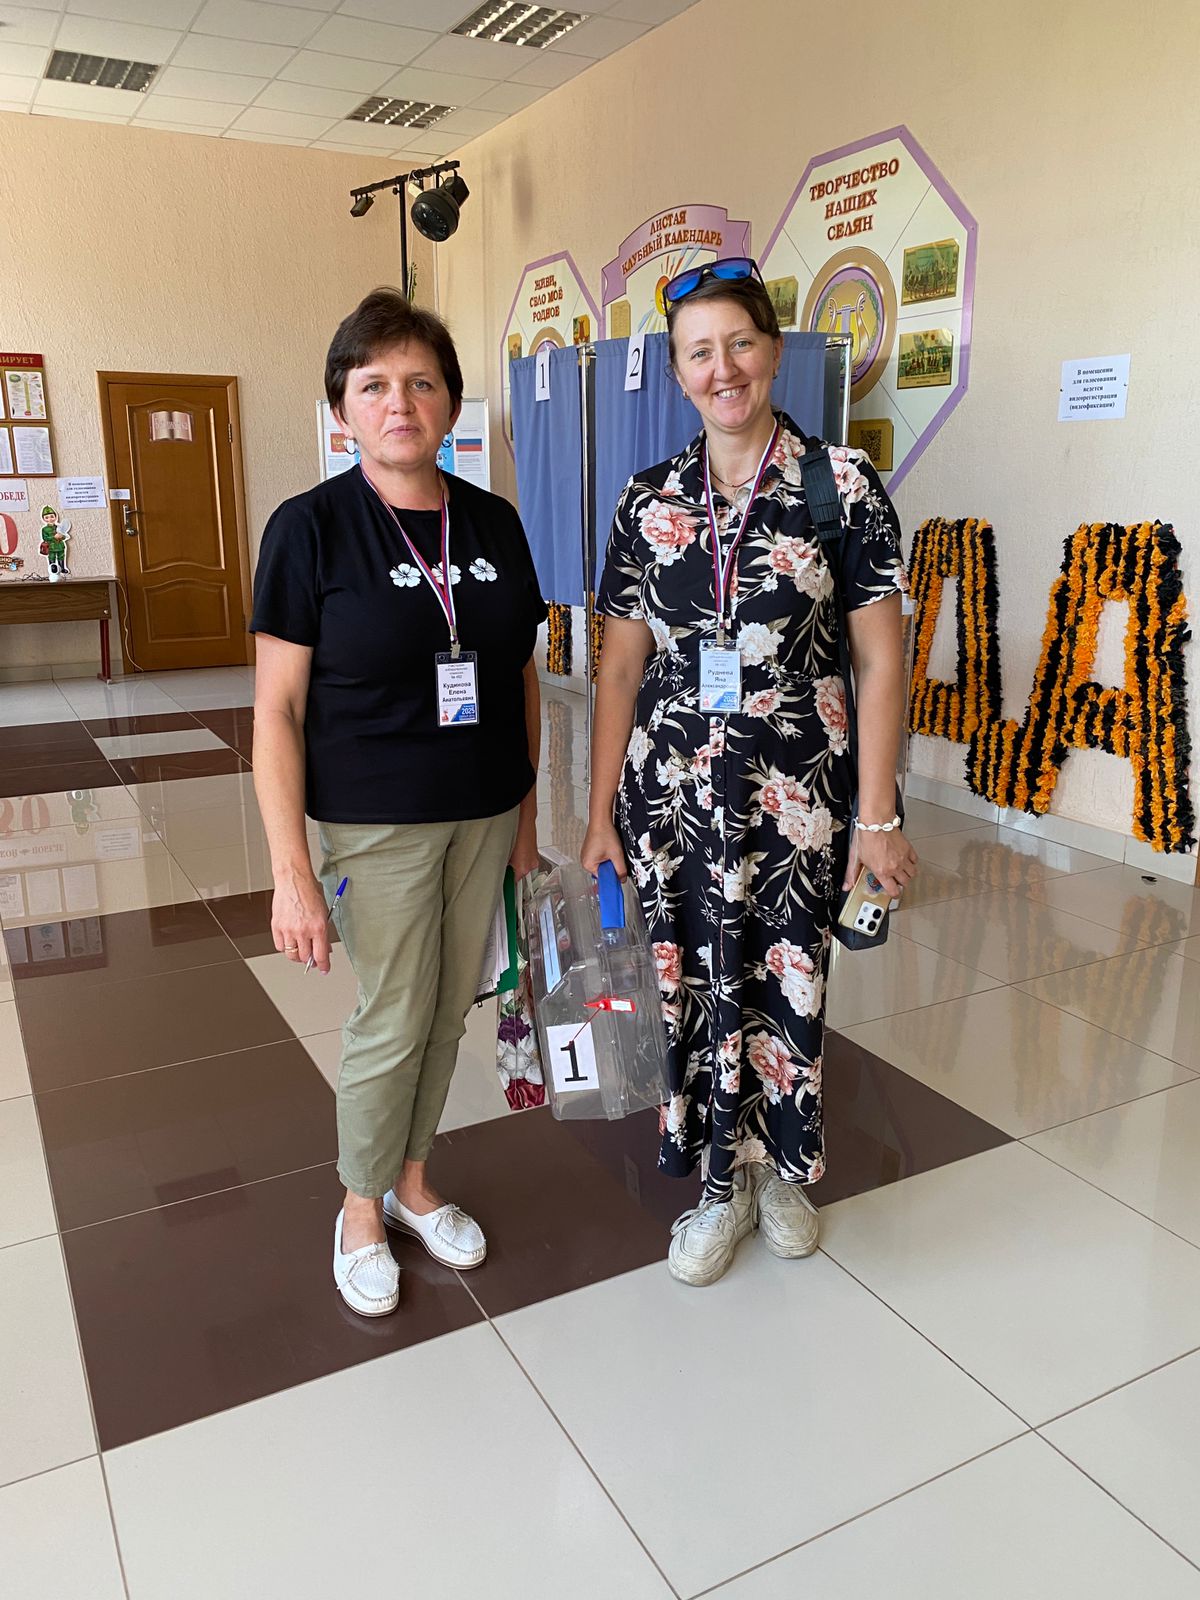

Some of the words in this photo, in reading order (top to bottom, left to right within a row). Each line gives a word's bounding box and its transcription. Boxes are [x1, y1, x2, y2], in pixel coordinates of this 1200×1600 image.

[809, 158, 899, 202] ТВОРЧЕСТВО
[824, 189, 877, 220] НАШИХ
[650, 210, 687, 235] ЛИСТАЯ
[827, 215, 873, 241] СЕЛЯН
[621, 233, 662, 275] КЛУБНЫЙ
[664, 229, 722, 246] КАЛЕНДАРЬ
[534, 275, 557, 291] ЖИВИ,
[529, 293, 546, 308] СЕЛО
[532, 305, 560, 322] РОДНОЕ
[540, 362, 546, 389] 1
[629, 347, 640, 377] 2
[560, 1040, 588, 1082] 1
